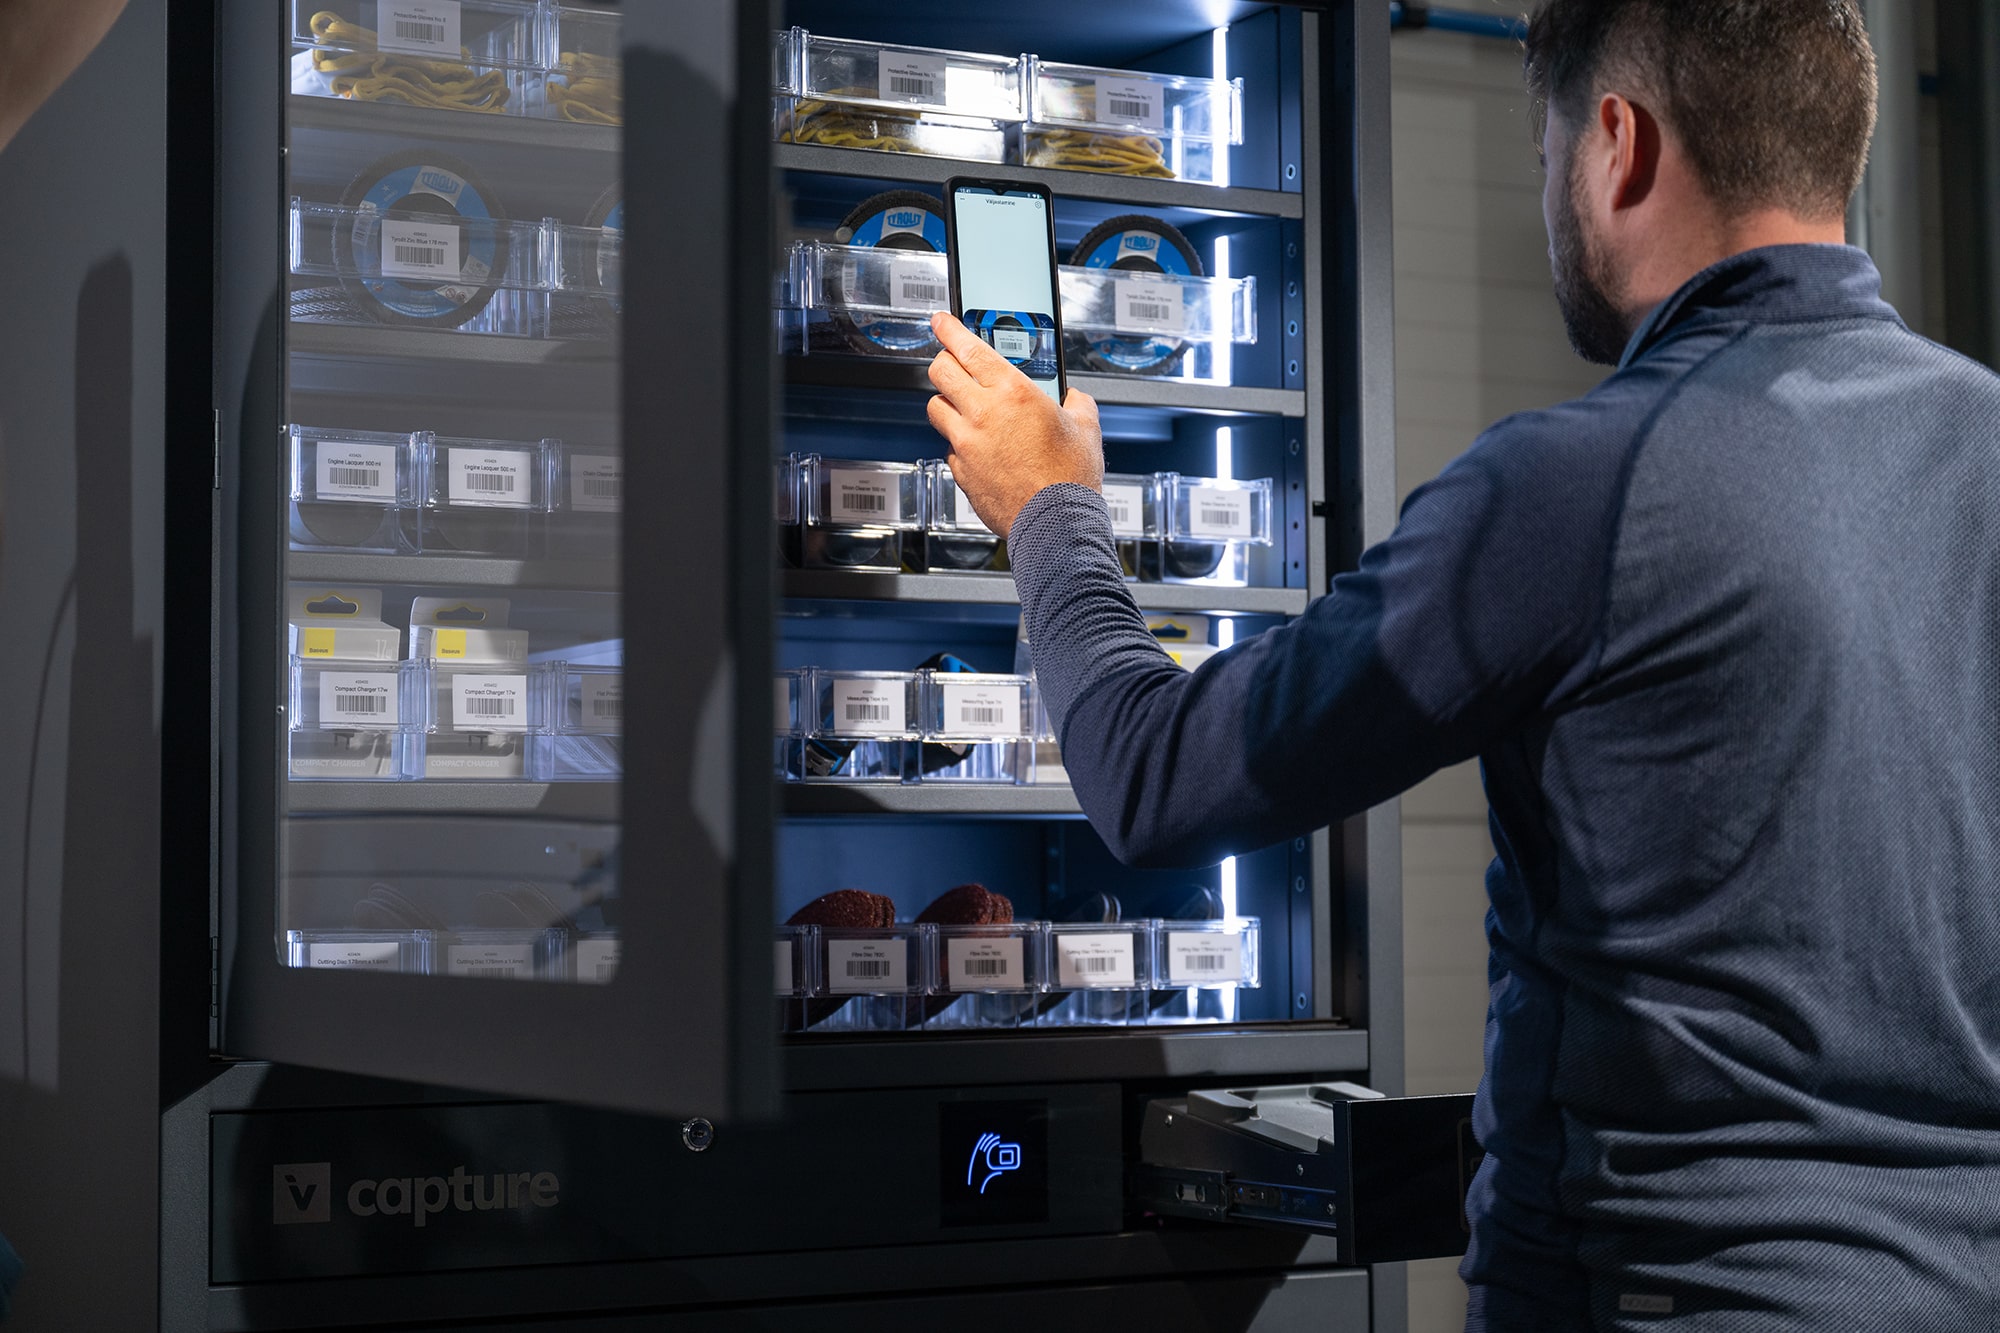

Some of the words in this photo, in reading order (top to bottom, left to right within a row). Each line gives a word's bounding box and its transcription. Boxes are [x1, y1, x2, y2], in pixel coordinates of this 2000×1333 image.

[421, 171, 460, 194] TYROLIT
[887, 212, 922, 228] TYROLIT
[1124, 236, 1156, 251] TYROLIT
[295, 759, 329, 768] COMPACT
[331, 760, 366, 768] CHARGER
[467, 760, 500, 768] CHARGER
[347, 1165, 560, 1228] capture
